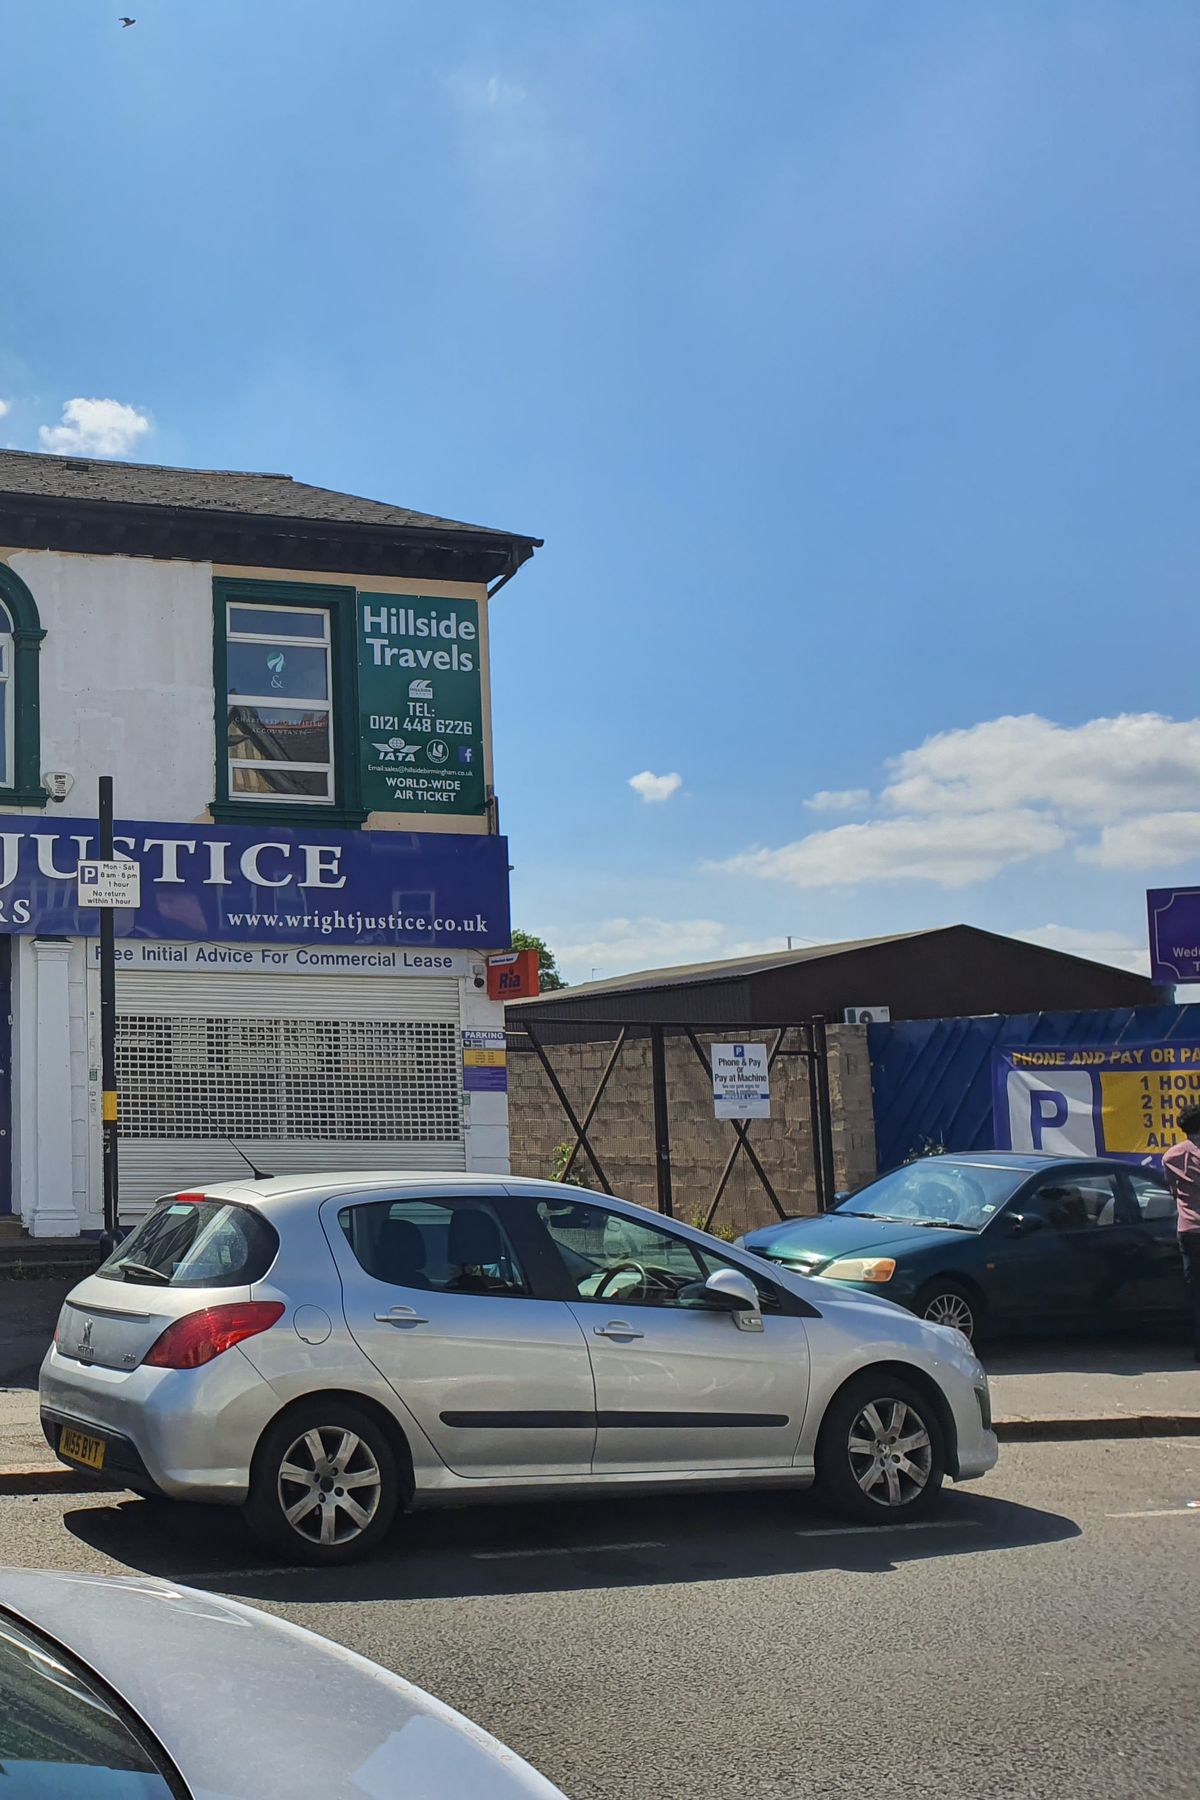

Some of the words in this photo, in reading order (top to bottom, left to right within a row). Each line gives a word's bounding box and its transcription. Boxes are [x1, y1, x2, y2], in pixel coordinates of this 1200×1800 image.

[363, 605, 476, 640] Hillside
[365, 637, 474, 672] Travels
[407, 702, 435, 717] TEL:
[370, 715, 399, 730] 0121
[403, 717, 431, 732] 448
[436, 719, 473, 735] 6226
[378, 751, 416, 762] IATA
[385, 777, 461, 791] WORLD-WIDE
[394, 789, 414, 801] AIR
[416, 790, 457, 802] TICKET
[84, 867, 96, 883] P
[227, 910, 488, 934] www.wrightjustice.co.uk
[95, 945, 134, 961] Fee
[142, 946, 188, 962] Initial
[196, 947, 253, 963] Advice
[261, 949, 289, 964] For
[296, 950, 396, 967] Commercial
[403, 952, 453, 969] Lease
[1172, 946, 1200, 958] Wed
[499, 966, 521, 988] Ria
[464, 1031, 504, 1039] PARKING
[718, 1058, 740, 1066] Phone
[749, 1058, 761, 1068] Pay
[1012, 1052, 1066, 1066] PHONE
[1069, 1052, 1105, 1065] AND
[1109, 1049, 1144, 1064] PAY
[1151, 1048, 1175, 1063] OR
[714, 1074, 727, 1083] Pay
[728, 1074, 736, 1082] at
[737, 1074, 767, 1082] Machine
[1140, 1075, 1149, 1090] 1
[1141, 1094, 1153, 1109] 2
[1030, 1090, 1068, 1150] P
[1143, 1113, 1153, 1128] 3
[81, 1436, 100, 1462] BYT
